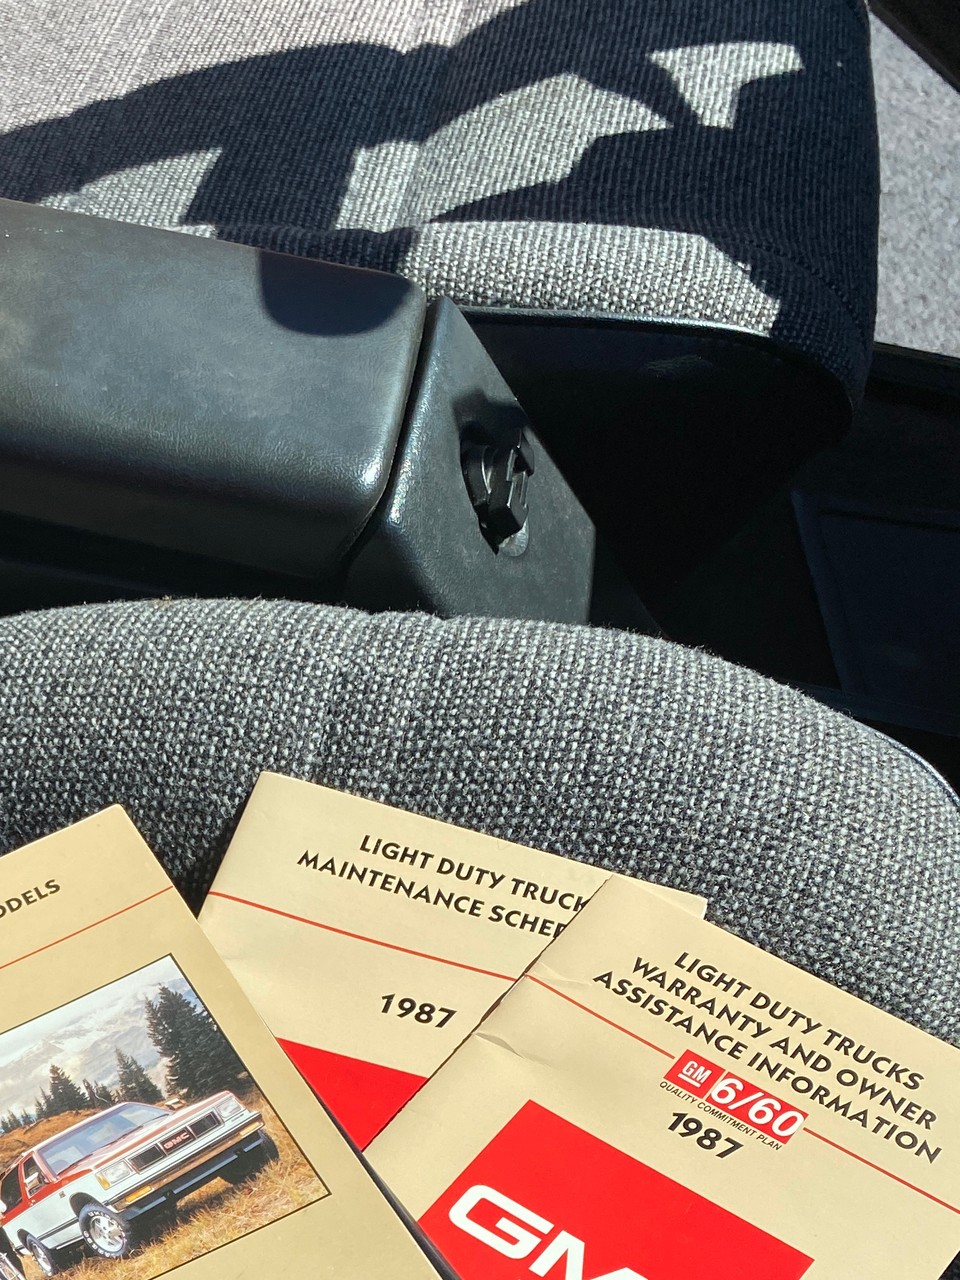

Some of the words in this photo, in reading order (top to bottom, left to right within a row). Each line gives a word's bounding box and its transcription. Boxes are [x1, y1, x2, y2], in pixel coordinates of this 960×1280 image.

[297, 850, 485, 918] MAINTENANCE
[359, 834, 434, 870] LIGHT
[437, 857, 506, 890] DUTY
[380, 993, 458, 1029] 1987
[633, 956, 773, 1041] WARRANTY
[769, 1036, 833, 1074] AND
[836, 1068, 938, 1131] OWNER
[674, 951, 752, 998] LIGHT
[755, 991, 823, 1036] DUTY
[823, 1028, 925, 1091] TRUCKS
[593, 970, 752, 1061] ASSISTANCE
[746, 1052, 943, 1165] INFORMATION
[682, 1060, 712, 1084] GM
[711, 1077, 805, 1137] 6/60
[659, 1081, 697, 1104] QUALITY
[697, 1102, 757, 1141] COMMITMENT
[756, 1134, 783, 1151] PLAN
[668, 1112, 744, 1159] 1987
